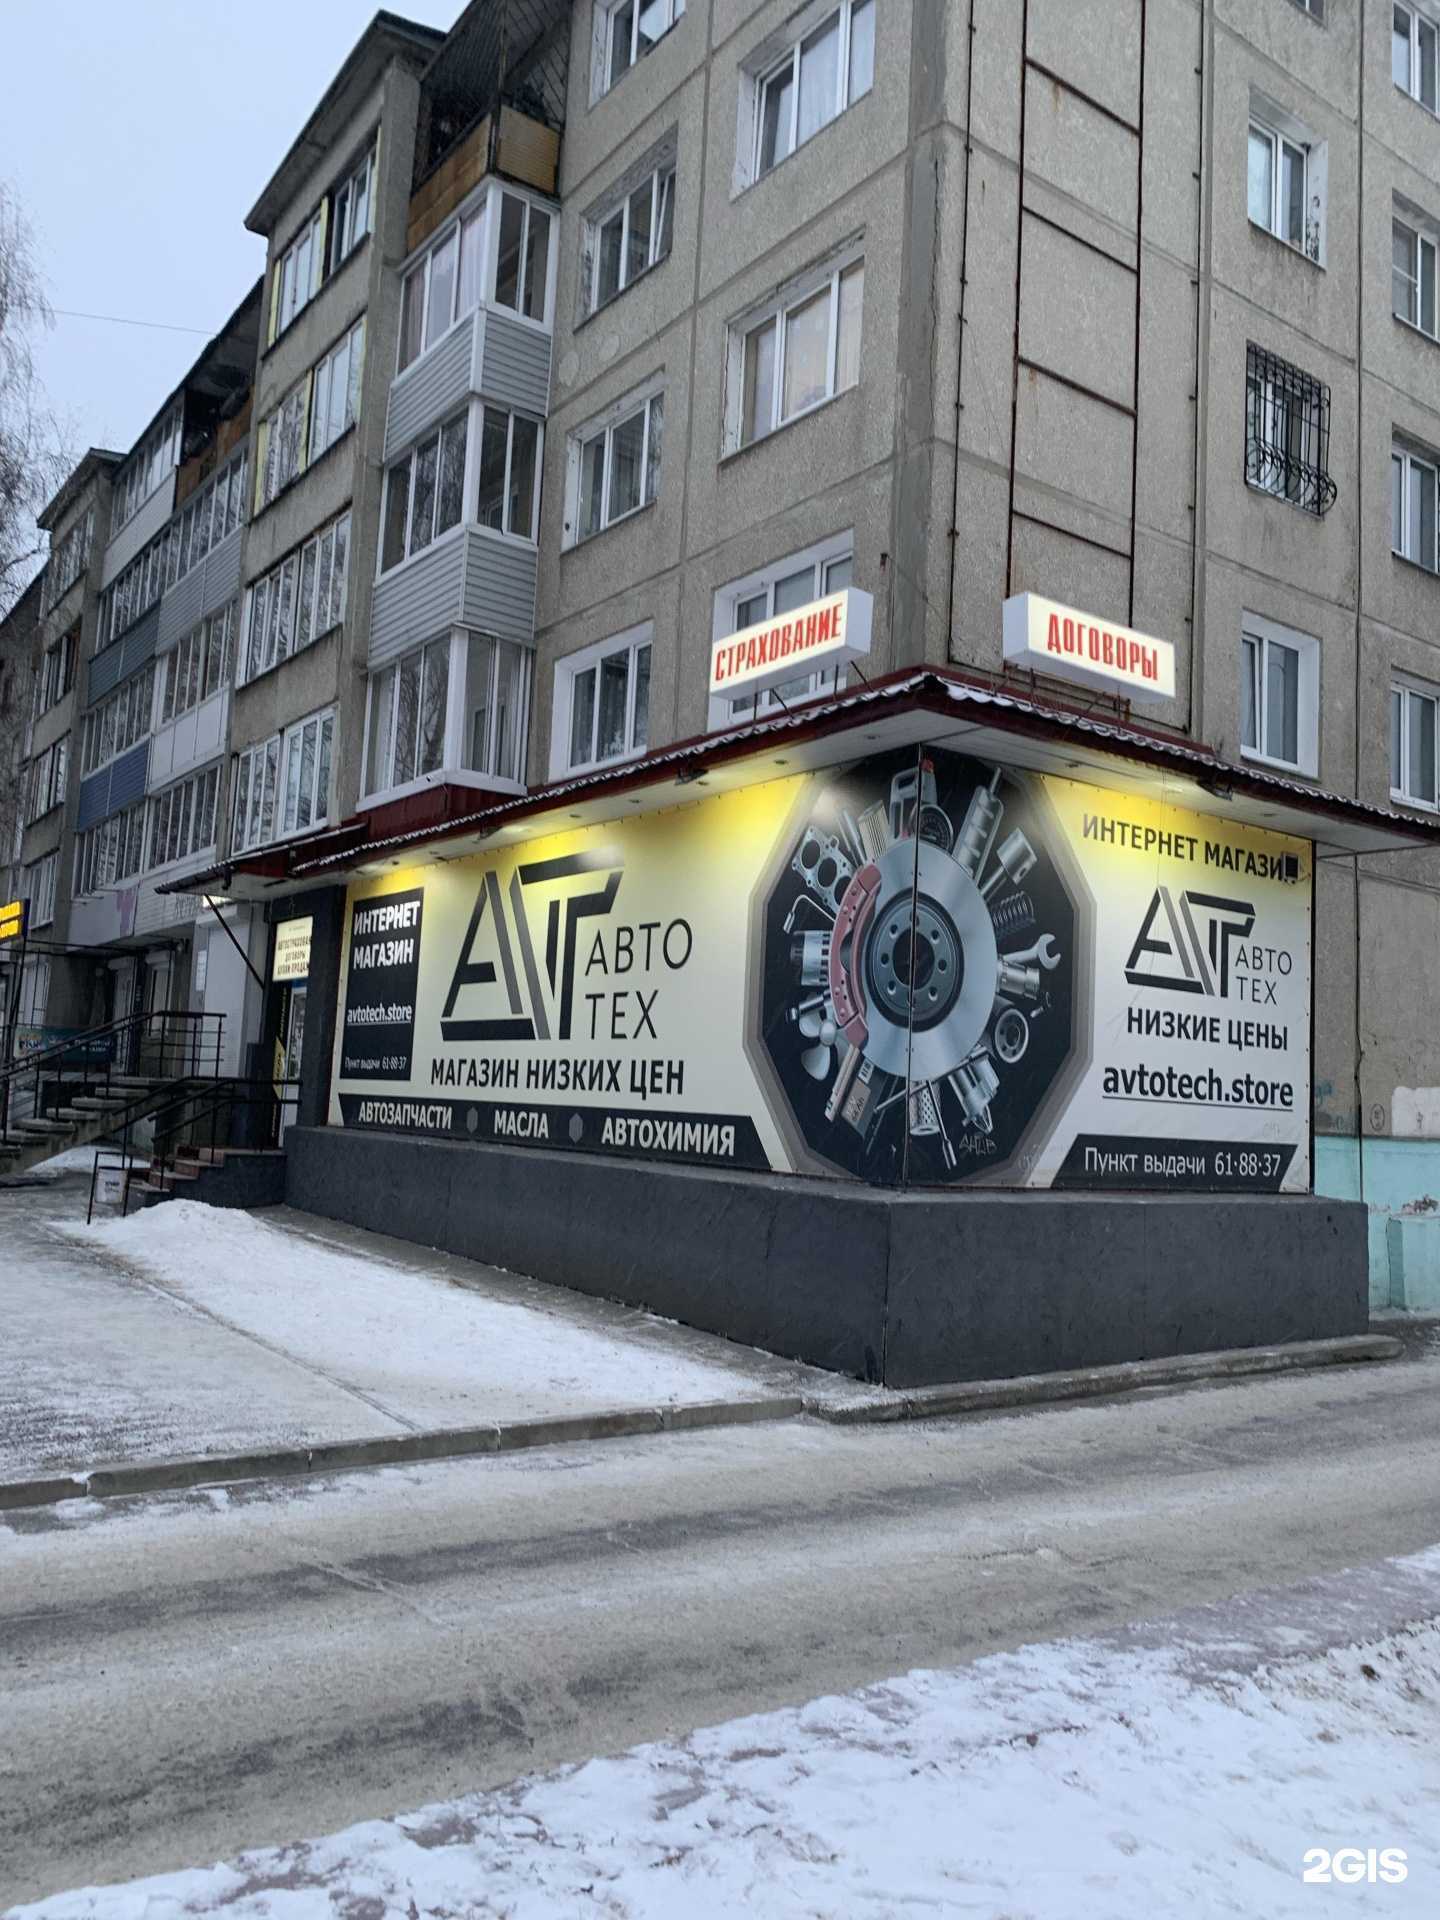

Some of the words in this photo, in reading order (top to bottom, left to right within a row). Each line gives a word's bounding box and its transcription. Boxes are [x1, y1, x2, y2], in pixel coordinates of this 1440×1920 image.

[714, 601, 843, 682] СТРАХОВАНИЕ
[1047, 612, 1158, 682] ДОГОВОРЫ
[1083, 813, 1198, 861] ИНТЕРНЕТ
[1204, 840, 1299, 881] МАГАЗИ
[353, 901, 420, 935] ИНТЕРНЕТ
[353, 938, 414, 970] МАГАЗИН
[585, 918, 692, 976] АВТО
[1235, 943, 1293, 976] АВТО
[347, 1002, 413, 1023] avtotech.store
[1236, 975, 1278, 1006] ТЕХ
[585, 989, 659, 1041] ТЕХ
[1127, 1006, 1221, 1044] НИЗКИЕ
[1228, 1019, 1289, 1051] ЦЕНЫ
[431, 1058, 519, 1088] МАГАЗИН
[526, 1059, 622, 1093] НИЗКИХ
[629, 1060, 684, 1101] ЦЕН
[1103, 1063, 1294, 1107] avtotech.store
[358, 1101, 452, 1130] АВТОЗАПЧАСТИ
[494, 1109, 549, 1139] МАСЛА
[601, 1116, 735, 1157] АВТОХИМИЯ
[1085, 1147, 1138, 1176] Пункт
[1144, 1154, 1206, 1177] выдачи
